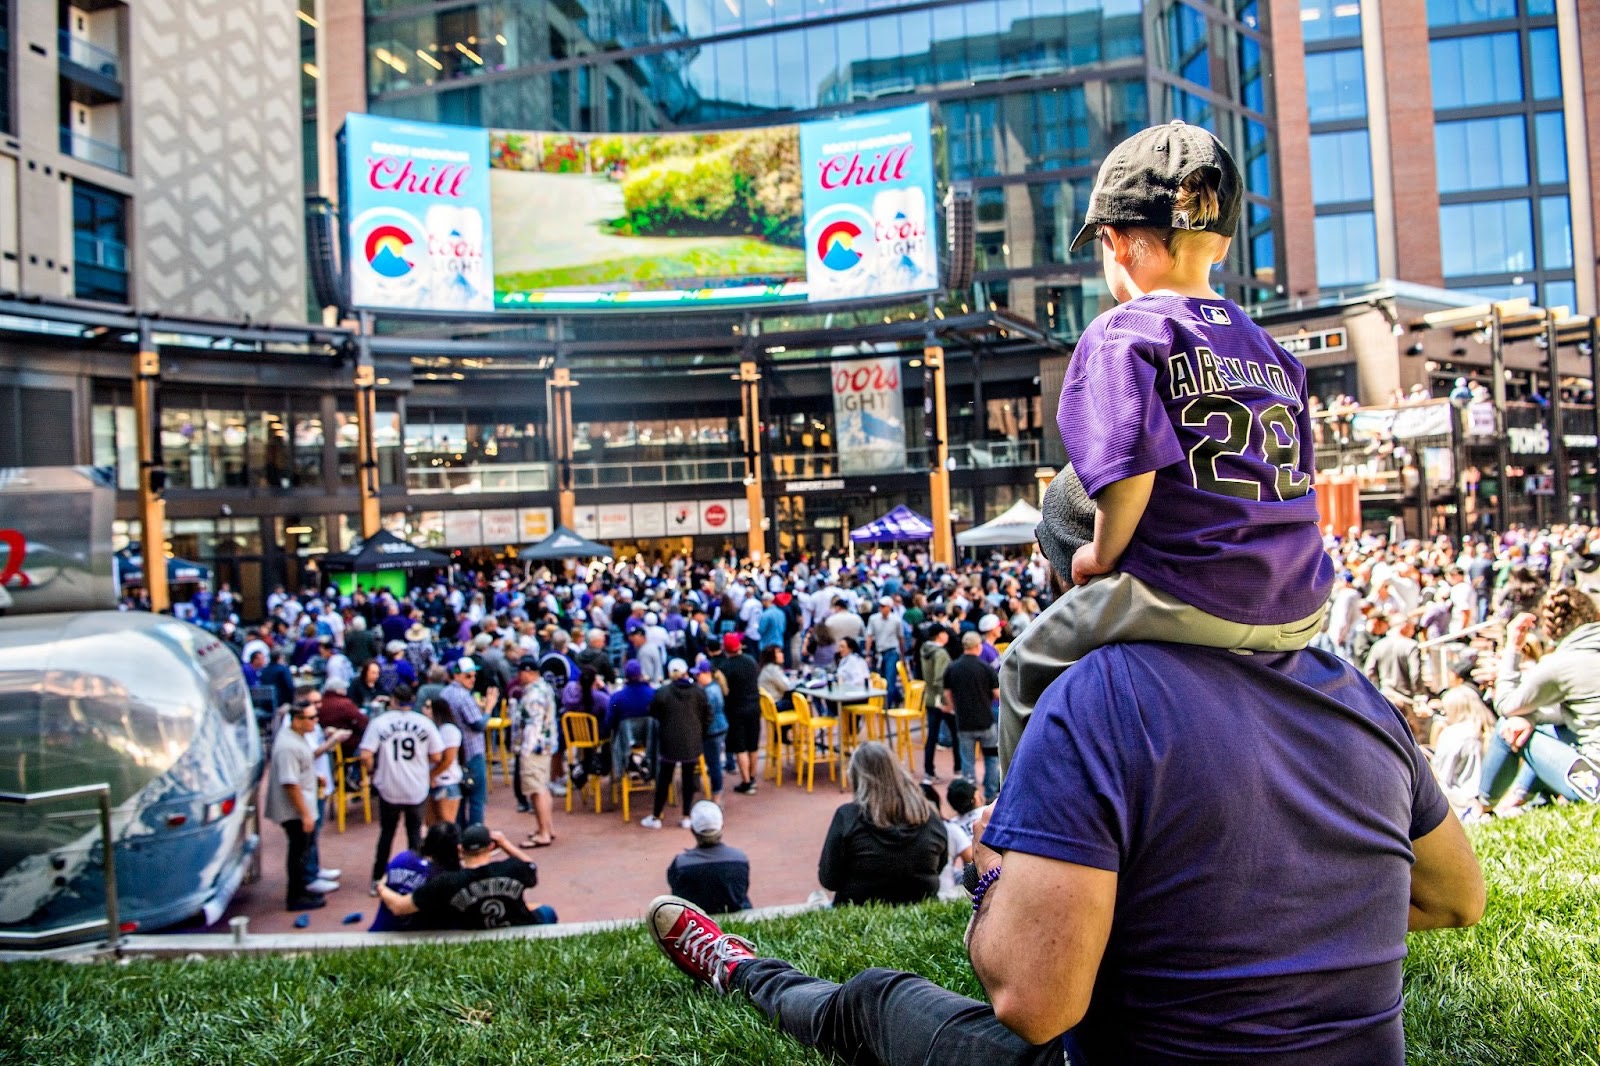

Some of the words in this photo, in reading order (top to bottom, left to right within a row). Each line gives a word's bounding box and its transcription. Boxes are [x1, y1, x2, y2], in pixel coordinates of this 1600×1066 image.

[367, 156, 471, 197] Chill
[818, 144, 914, 189] Chill
[831, 364, 900, 394] oors
[835, 391, 889, 414] IGHT
[1181, 394, 1311, 502] 28
[393, 737, 416, 762] 19
[480, 899, 511, 928] 2
